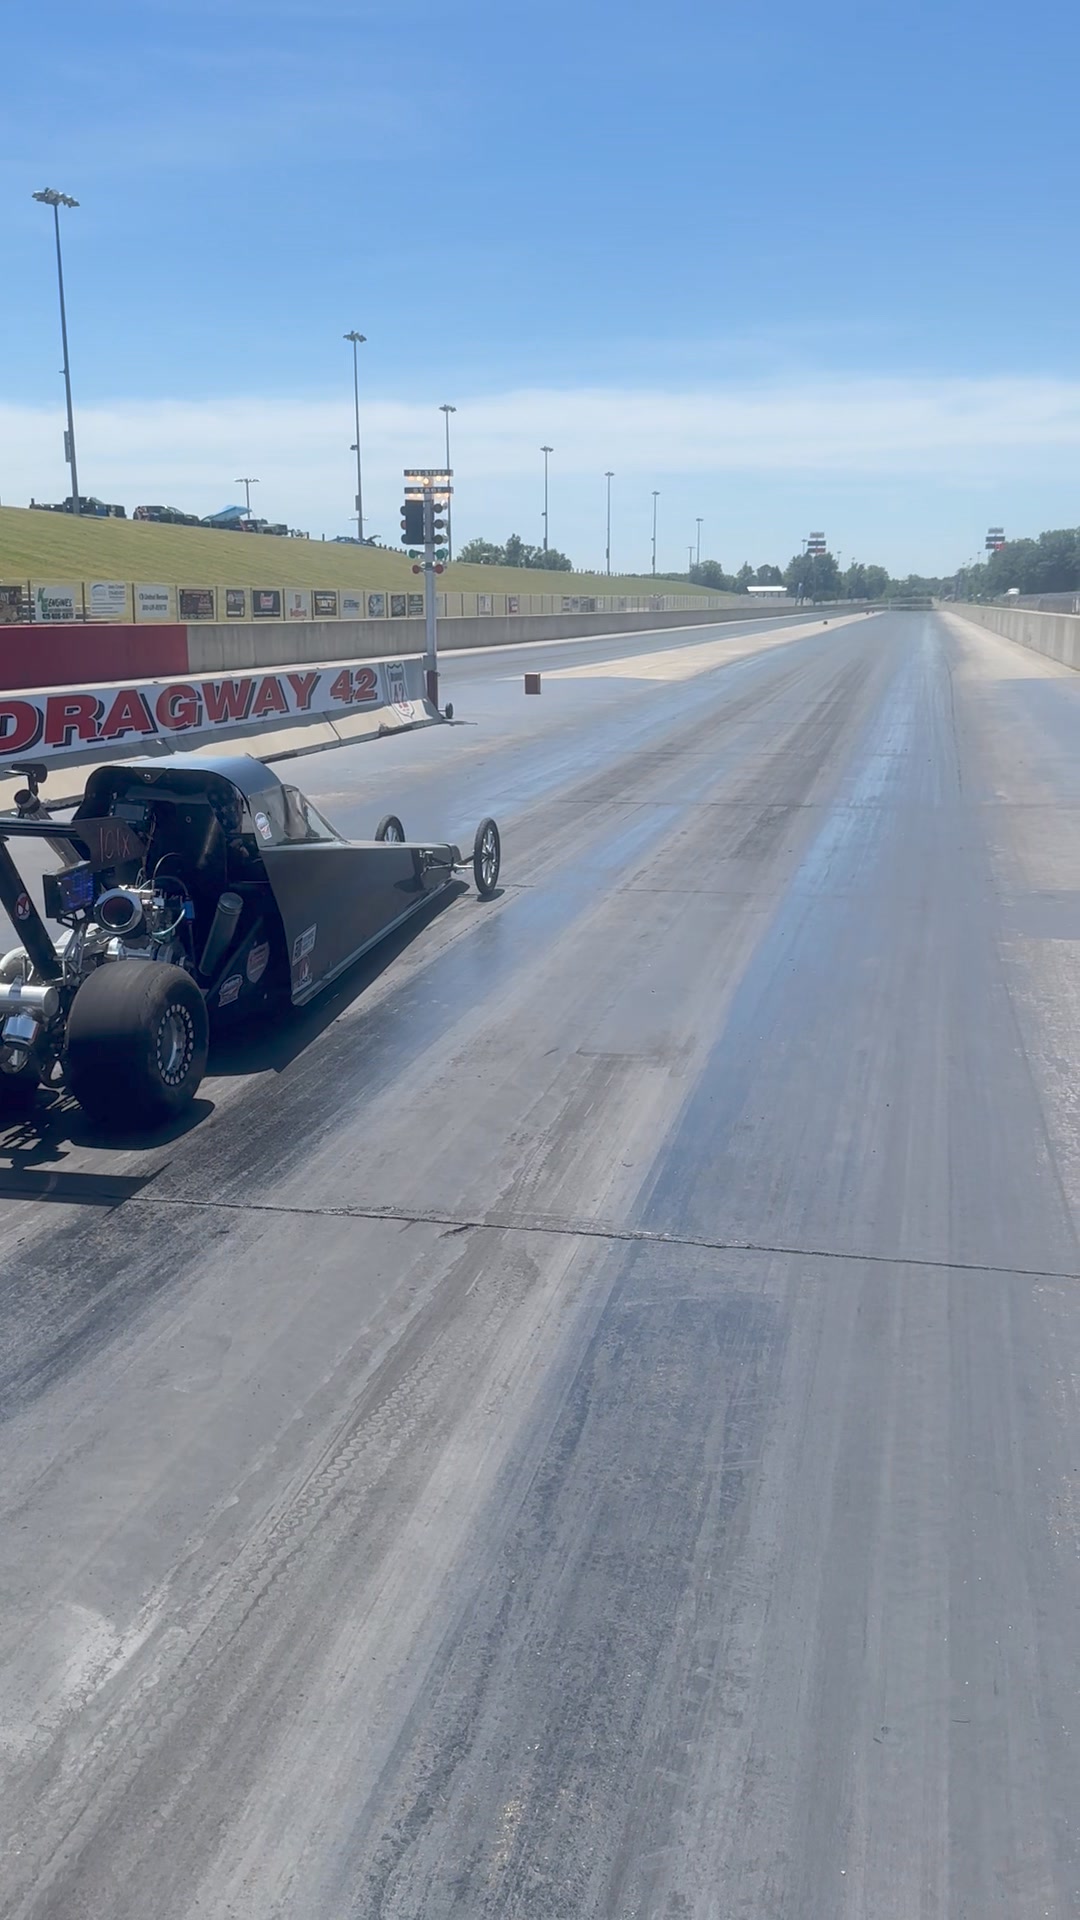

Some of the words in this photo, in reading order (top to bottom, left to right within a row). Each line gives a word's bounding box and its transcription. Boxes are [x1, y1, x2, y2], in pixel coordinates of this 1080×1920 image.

[48, 598, 72, 607] ENGINES
[0, 672, 321, 754] DRAGWAY
[330, 667, 378, 704] 42
